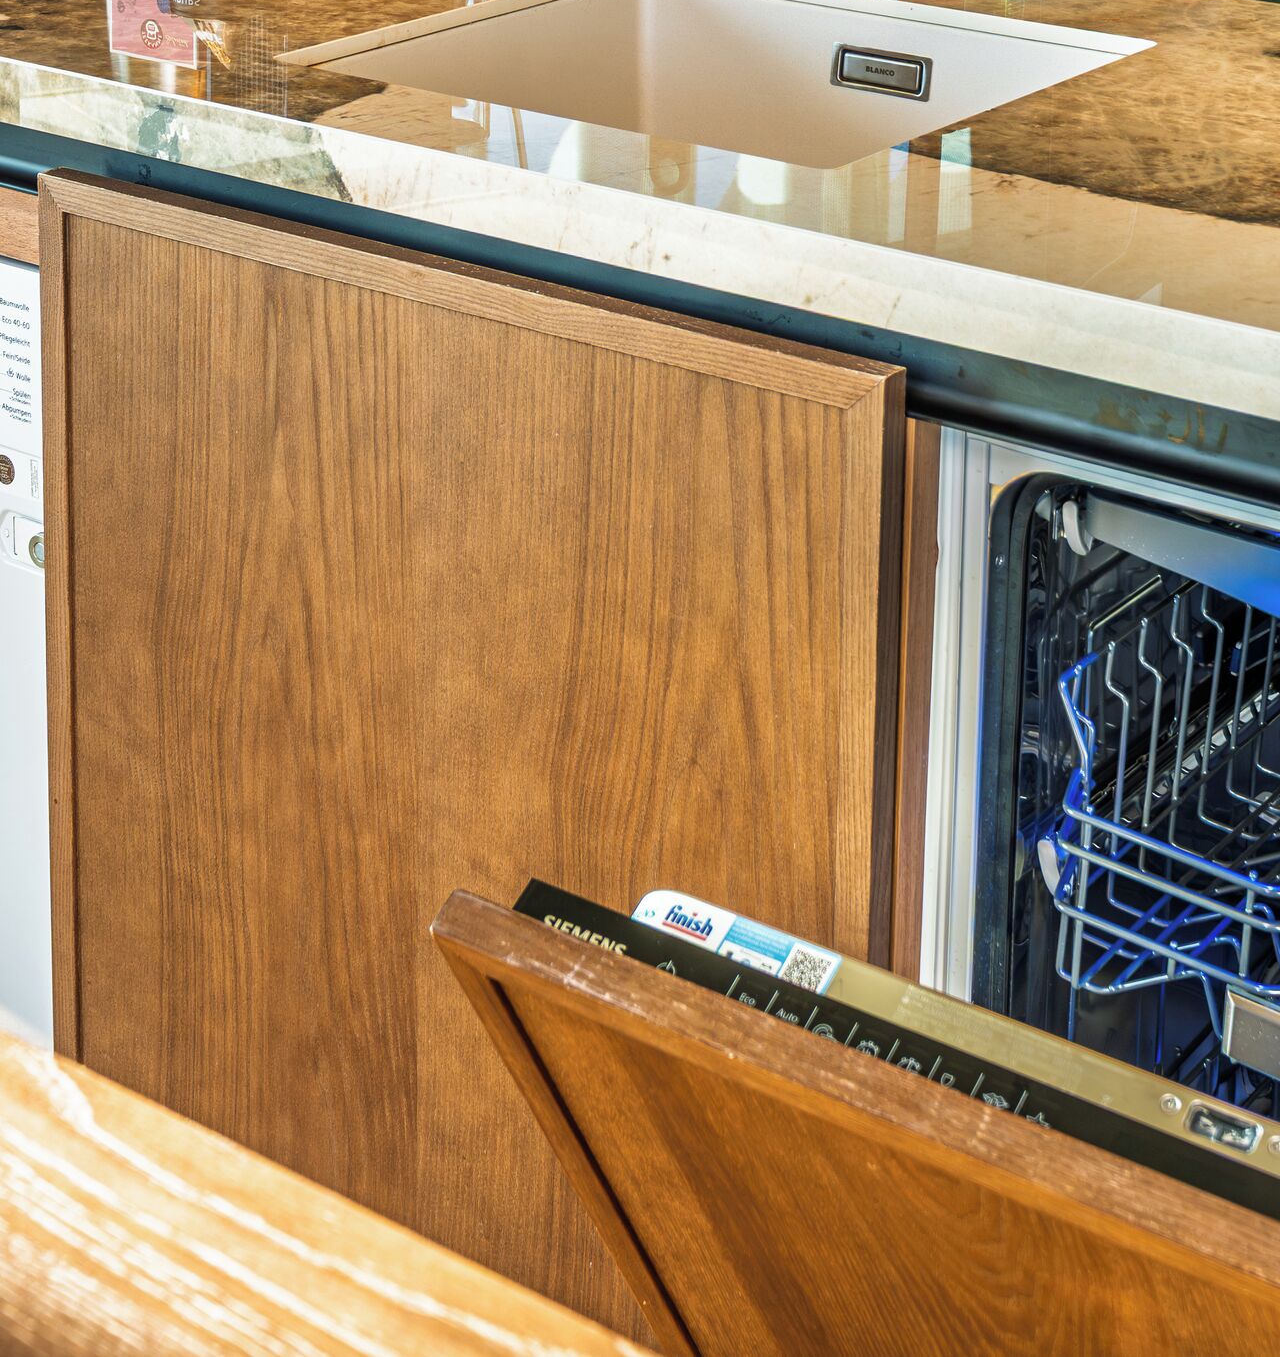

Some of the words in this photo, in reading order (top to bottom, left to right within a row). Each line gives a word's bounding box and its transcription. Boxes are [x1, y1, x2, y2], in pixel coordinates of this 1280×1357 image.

[865, 65, 896, 77] BLANCO
[0, 297, 30, 313] Baumwolle
[1, 315, 12, 325] Eco
[12, 318, 31, 330] 40-60
[15, 371, 31, 383] Wolle
[1, 402, 32, 419] Abpumpen
[663, 902, 714, 937] finish
[737, 991, 758, 1008] Eco
[776, 1006, 801, 1025] Auto
